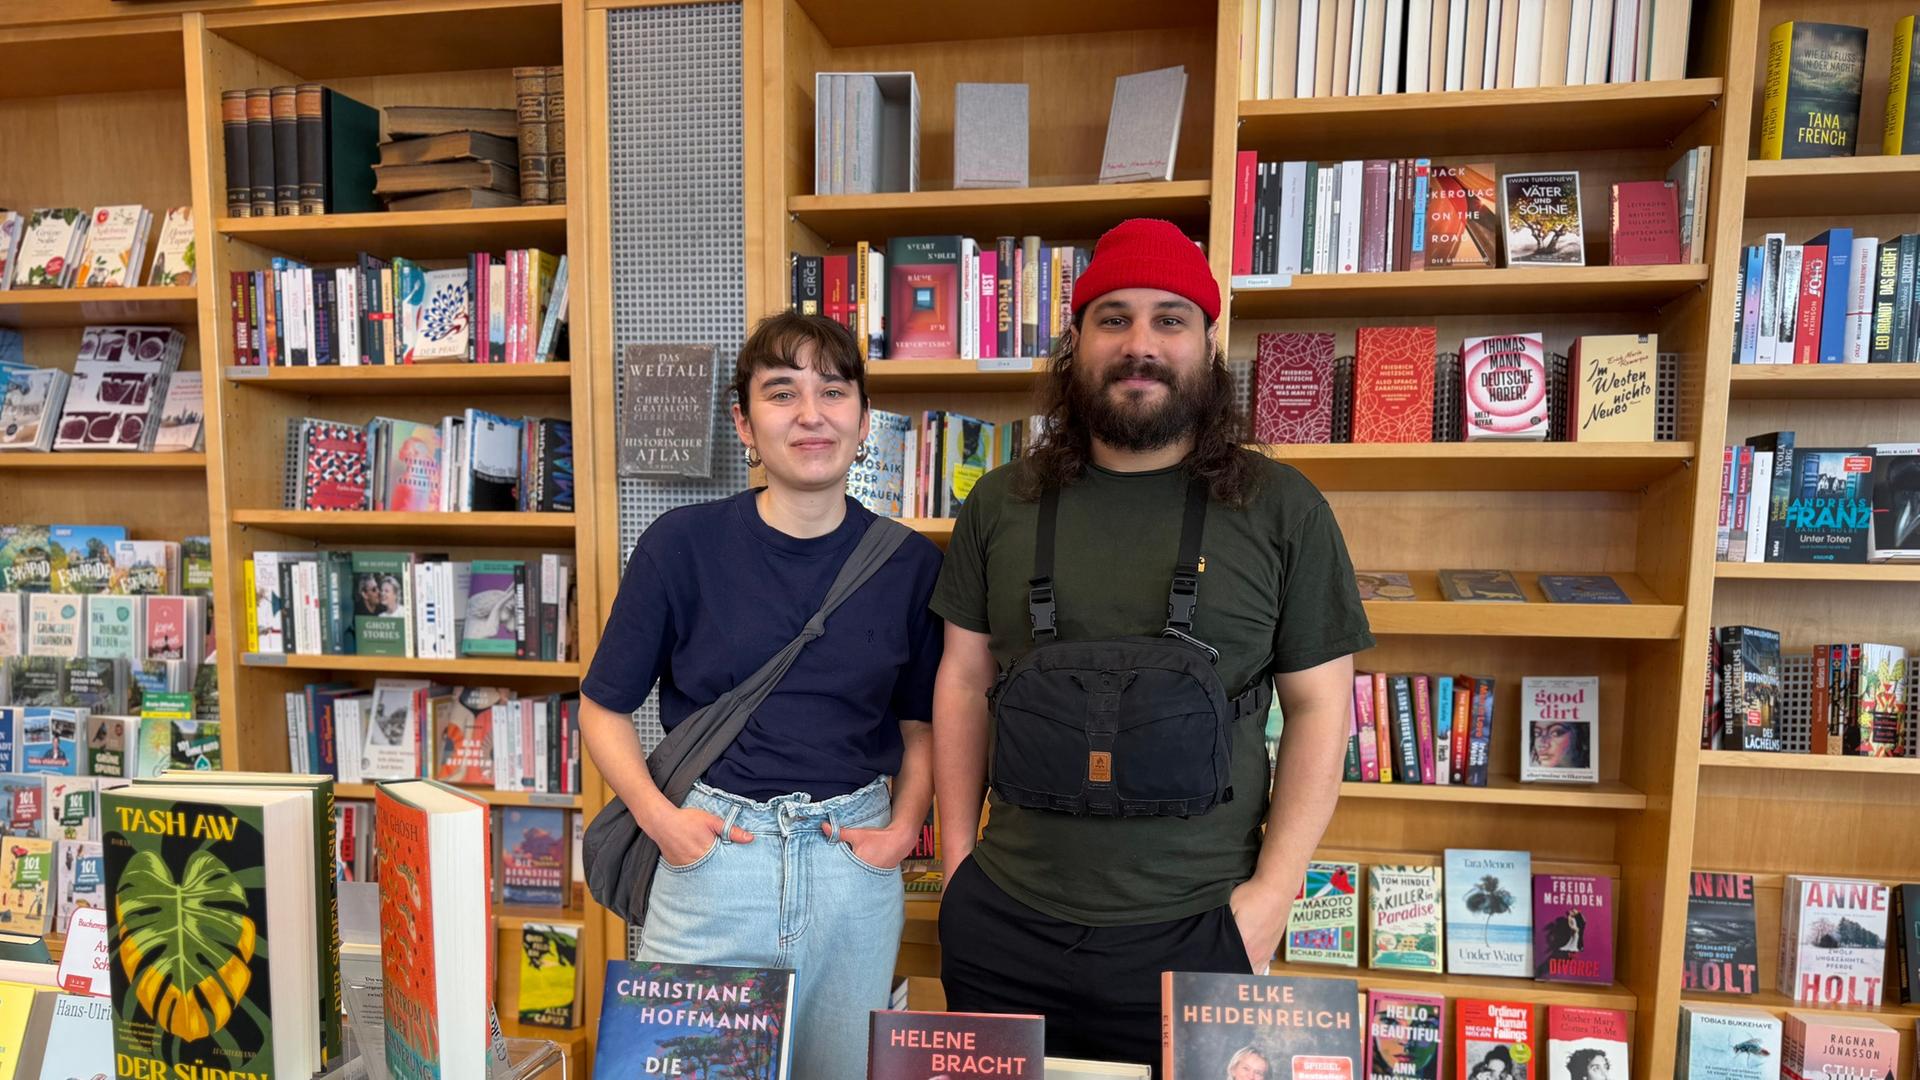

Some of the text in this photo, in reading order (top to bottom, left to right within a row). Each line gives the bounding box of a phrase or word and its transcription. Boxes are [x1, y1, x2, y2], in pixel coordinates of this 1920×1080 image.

[1813, 61, 1856, 72] DER NACHT
[1808, 112, 1840, 129] TANA
[1798, 128, 1846, 146] FRENCH
[1432, 167, 1465, 178] JACK
[1509, 176, 1530, 184] IWAN
[1432, 188, 1495, 199] KEROUAC
[1522, 185, 1562, 198] VÄTER
[1432, 211, 1480, 221] ON THE
[1519, 202, 1569, 215] SÖHNE
[1432, 233, 1468, 243] ROAD
[1620, 229, 1674, 237] DEUTSCHLAND
[1879, 247, 1897, 295] DAS GEHÖFT
[1901, 253, 1915, 283] ENDZEIT
[806, 260, 817, 297] CIRCE
[982, 273, 995, 296] NEST
[998, 278, 1013, 332] Frieda
[1802, 309, 1811, 328] KATE
[1808, 300, 1818, 336] ATKINSON
[1875, 302, 1893, 350] LEO BRANDT
[1482, 336, 1526, 354] THOMAS
[659, 353, 680, 362] DAS
[1489, 353, 1521, 370] MANN
[630, 364, 709, 378] WELTALL
[1481, 368, 1533, 387] DEUTSCHE
[1586, 359, 1608, 382] Im
[1592, 370, 1647, 396] Westen
[636, 395, 697, 404] CHRISTIAN
[1613, 380, 1651, 405] nichts
[634, 404, 699, 412] GRATALOUP
[1583, 402, 1628, 430] Neues
[655, 428, 675, 436] EIN
[625, 439, 703, 447] HISTORISCHER
[636, 449, 690, 464] ATLAS
[1776, 444, 1786, 476] NICOLA
[1784, 449, 1793, 472] FÖRG
[856, 458, 902, 472] MOSAIK
[536, 461, 545, 501] MIAMI
[855, 472, 878, 483] DER
[854, 486, 901, 501] FRAUEN
[1792, 498, 1866, 507] ANDREAS
[1786, 507, 1873, 528] FRANZ
[1800, 534, 1852, 543] Unter Toten
[365, 621, 396, 630] GHOST
[363, 630, 400, 640] STORIES
[1768, 666, 1777, 674] DIE
[1733, 649, 1743, 714] DES LÄCHELNS
[1744, 672, 1779, 686] ERFINDUNG
[1535, 689, 1584, 706] good
[1724, 664, 1733, 734] DIE ERFINDUNG
[1418, 679, 1430, 740] Ordinary Saints
[1540, 705, 1580, 720] dirt
[1457, 706, 1465, 733] MARTIAN
[1475, 716, 1486, 737] Love
[1398, 692, 1414, 766] LONG BRIGHT RIVER
[1763, 728, 1773, 737] DES
[1745, 735, 1780, 751] LÄCHELNS
[1438, 744, 1447, 762] Flesh
[1470, 742, 1478, 766] Welsh
[1477, 742, 1486, 765] Irvine
[19, 791, 34, 804] 101
[70, 794, 83, 807] 101
[115, 807, 239, 842] TASH AW
[389, 813, 418, 842] GHOSH
[24, 857, 40, 870] 101
[82, 860, 96, 874] 101
[515, 859, 532, 867] DIE
[1464, 859, 1514, 869] Tara Menon
[506, 868, 560, 878] BERNSTEIN
[506, 877, 560, 887] FISCHERIN
[1381, 877, 1431, 887] TOM HINDLE
[1553, 880, 1593, 893] FREIDA
[1302, 896, 1353, 910] MAKOTO
[1377, 888, 1434, 912] A KILLER in
[1544, 892, 1603, 907] McFADDEN
[1806, 881, 1888, 911] ANNE
[1293, 907, 1353, 923] MURDERS
[1377, 903, 1434, 927] Paradise
[1290, 949, 1354, 959] RICHARD JERRAM
[1459, 948, 1524, 963] Under Water
[1695, 944, 1737, 952] DIAMANTEN
[1699, 951, 1734, 960] UND ROST
[1550, 958, 1600, 977] DIVORCE
[1682, 962, 1756, 994] HOLT
[617, 979, 752, 1003] CHRISTIANE
[1238, 984, 1294, 1004] ELKE
[1802, 973, 1881, 1006] HOLT
[545, 1007, 569, 1017] ALEX
[1184, 1005, 1351, 1030] HEIDENREICH
[1387, 1004, 1428, 1022] HELLO
[1488, 1005, 1527, 1018] Ordinary
[534, 1014, 565, 1025] CAPUS
[641, 1008, 768, 1032] HOFFMANN
[1495, 1017, 1527, 1029] Human
[1561, 1014, 1615, 1027] Mother Mary
[1700, 1016, 1773, 1030] TOBIAS BUKKEHAVE
[1371, 1023, 1441, 1043] BEAUTIFUL
[1494, 1028, 1528, 1042] Failings
[1561, 1023, 1617, 1036] Comes To Me
[891, 1029, 976, 1050] HELENE
[1830, 1033, 1875, 1047] RAGNAR
[1823, 1044, 1881, 1060] JÓNASSON
[117, 1053, 167, 1080] DER
[646, 1057, 681, 1075] DIE
[932, 1054, 1027, 1075] BRACHT
[1304, 1062, 1341, 1071] SPIEGEL
[1392, 1061, 1416, 1075] ANN
